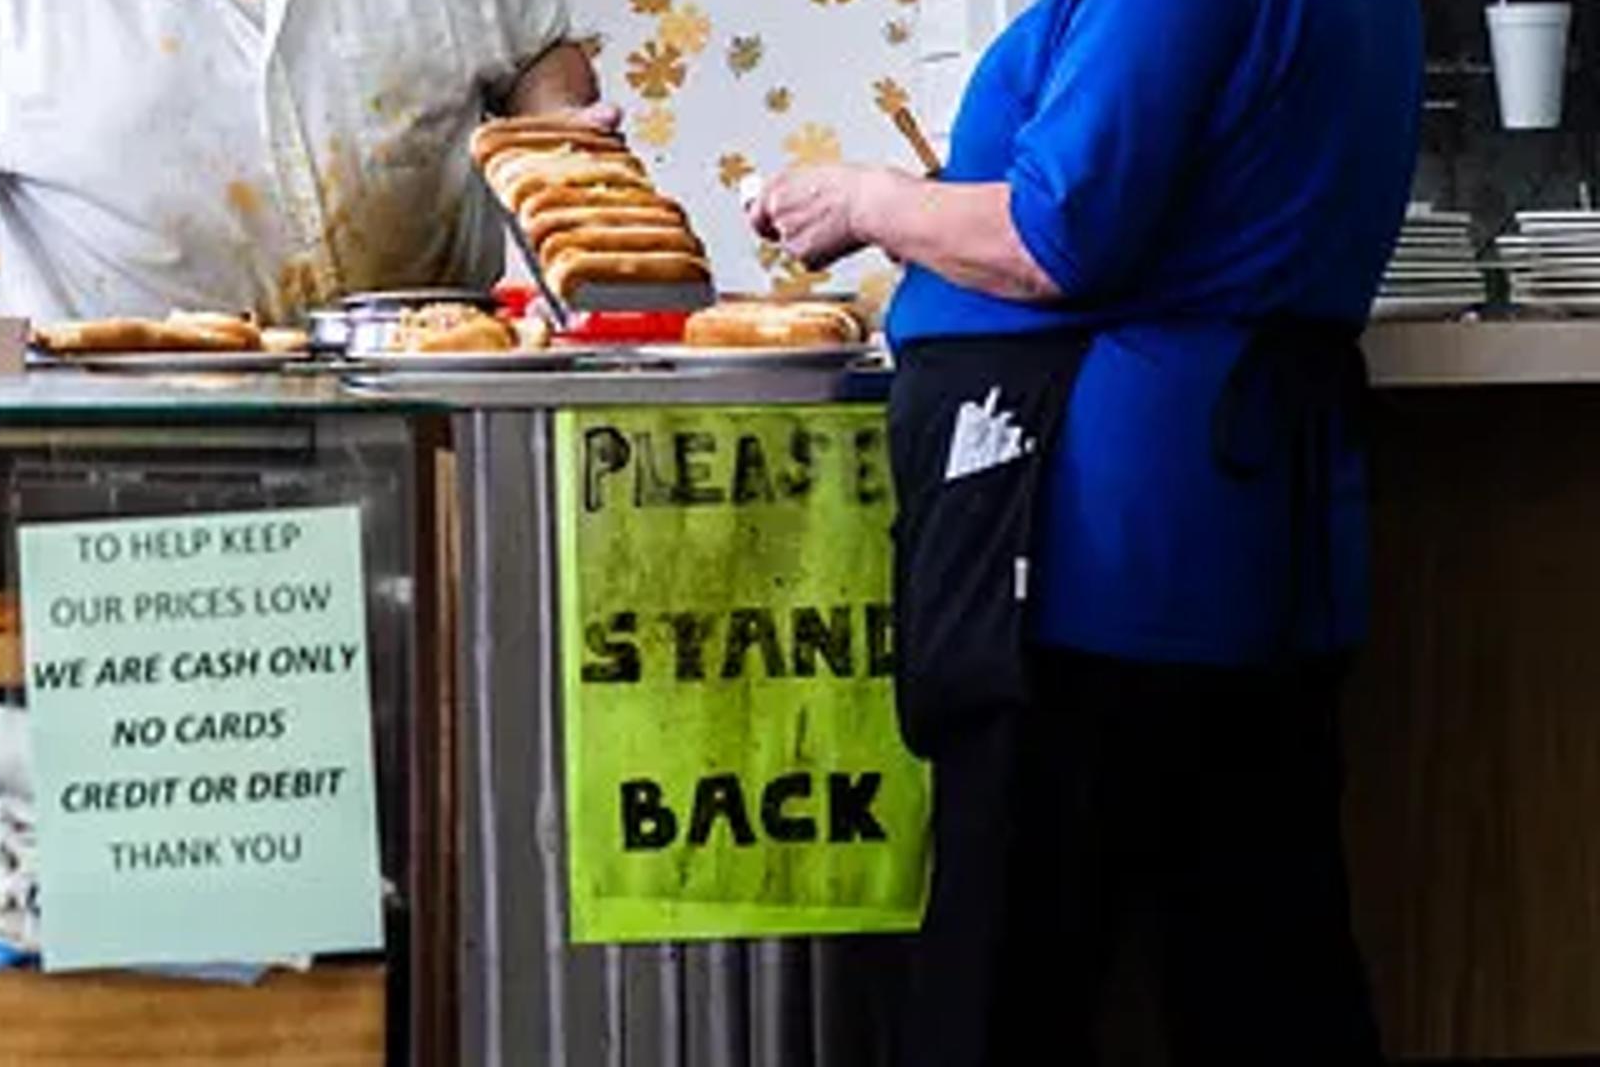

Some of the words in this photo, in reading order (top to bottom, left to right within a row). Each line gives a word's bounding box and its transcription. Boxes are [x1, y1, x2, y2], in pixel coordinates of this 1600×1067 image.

[582, 424, 886, 514] PLEASE
[76, 532, 122, 565] TO
[130, 527, 212, 561] HELP
[220, 521, 303, 555] KEEP
[49, 594, 126, 629] OUR
[134, 586, 246, 624] PRICES
[255, 583, 333, 616] LOW
[580, 600, 900, 684] STAND
[32, 656, 87, 692] WE
[95, 650, 164, 687] ARE
[170, 646, 262, 684] CASH
[268, 641, 359, 680] ONLY
[112, 714, 167, 748] NO
[174, 707, 288, 745] CARDS
[59, 775, 183, 814] CREDIT
[188, 773, 237, 806] OR
[246, 766, 347, 803] DEBIT
[618, 770, 890, 853] BACK
[110, 835, 223, 873] THANK
[229, 831, 303, 866] YOU
